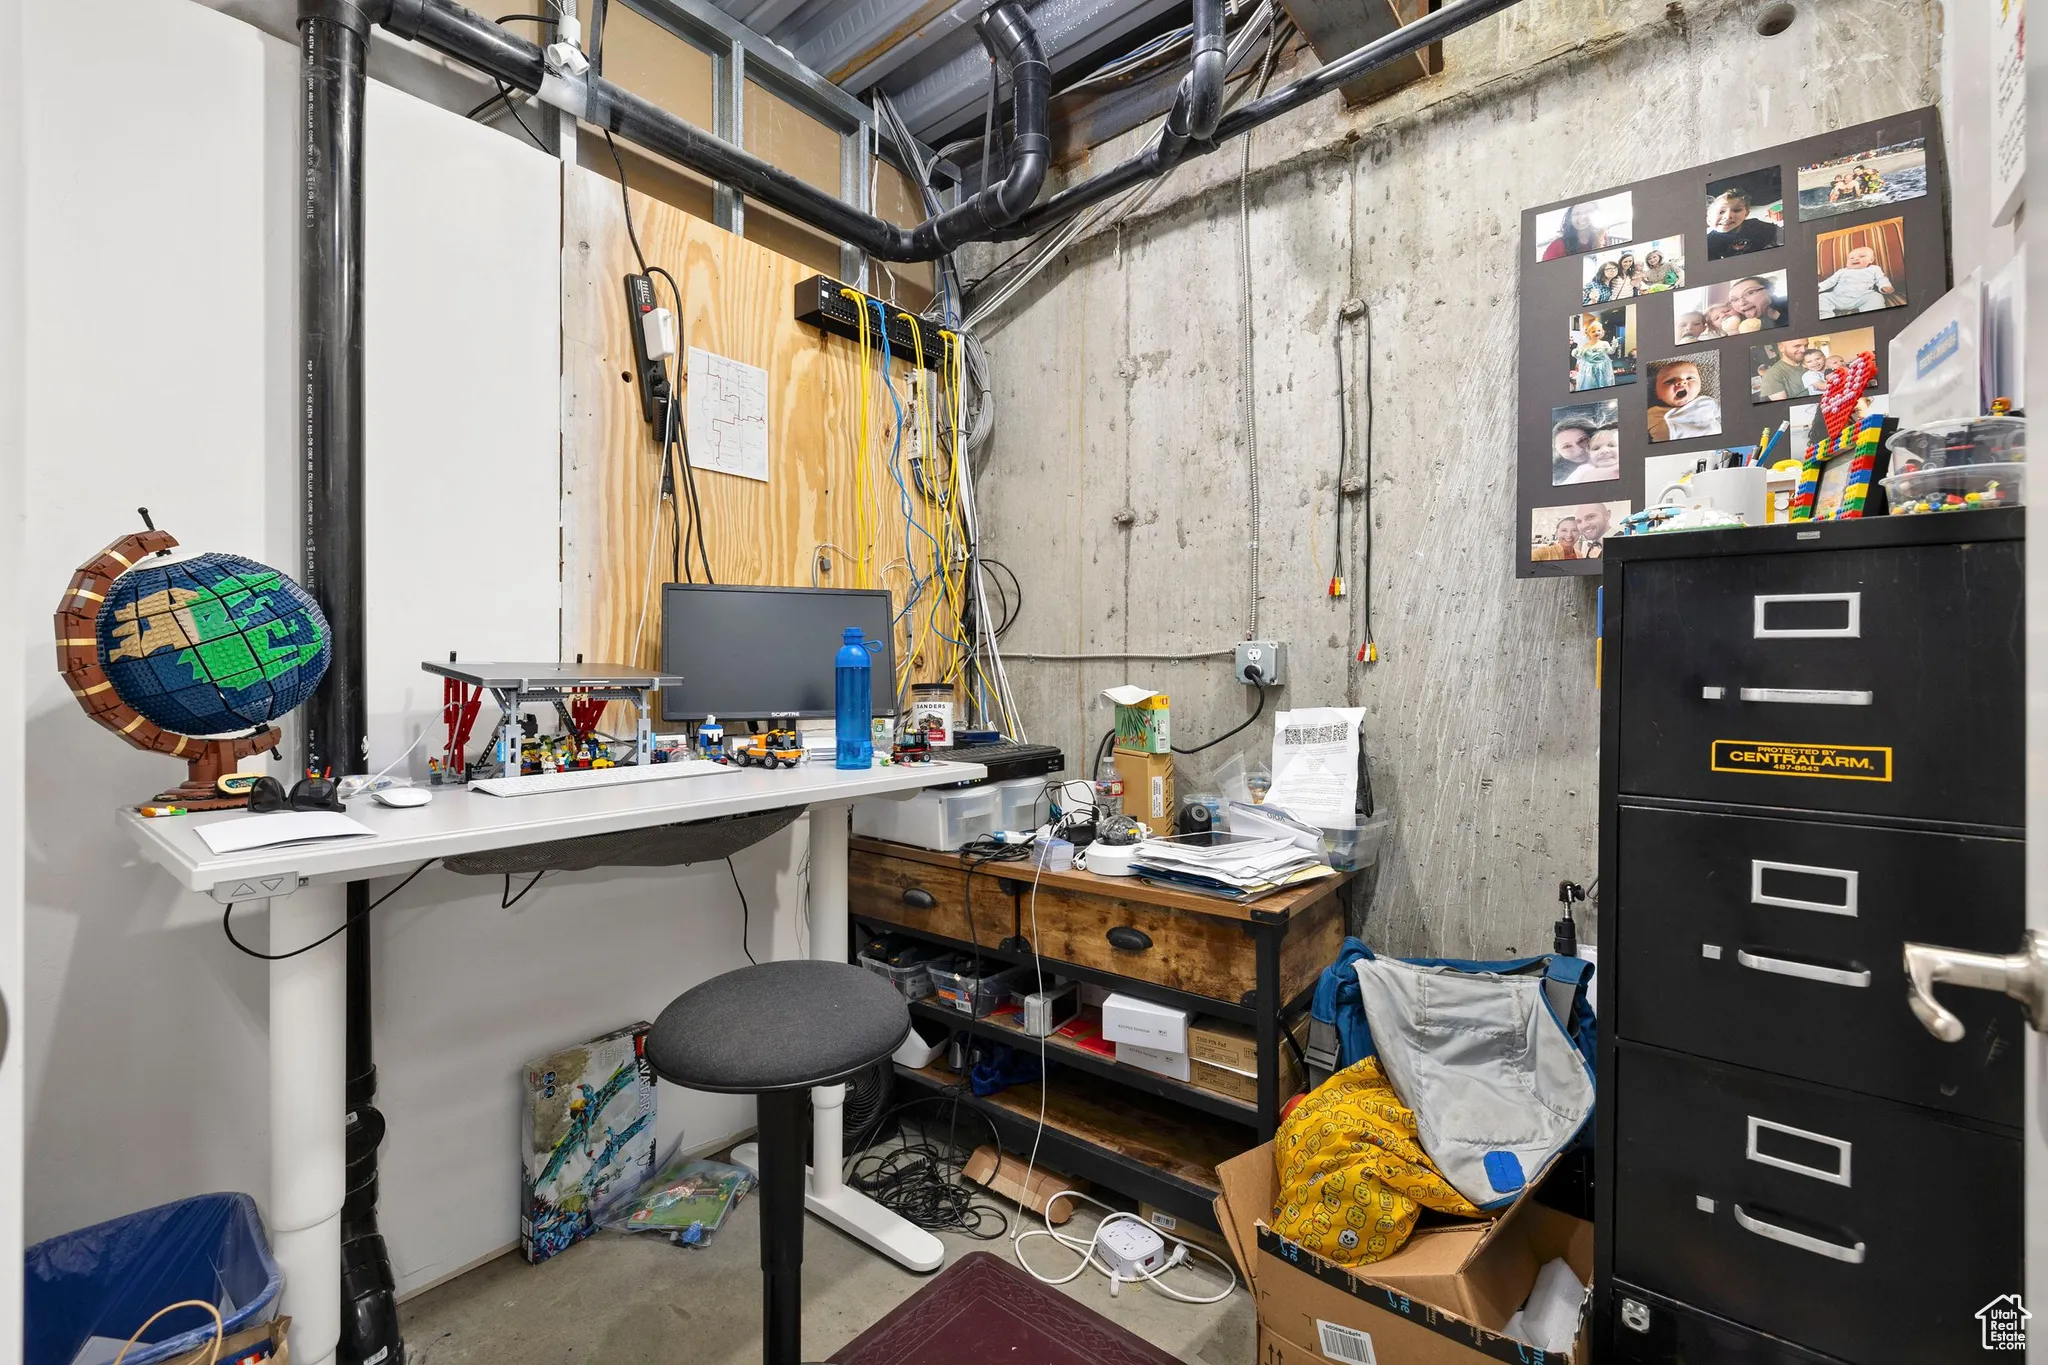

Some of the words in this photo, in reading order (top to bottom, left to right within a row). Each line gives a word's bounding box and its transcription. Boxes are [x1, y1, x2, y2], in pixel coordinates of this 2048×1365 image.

[1757, 746, 1819, 755] PROTECTED
[1729, 751, 1869, 769] CENTRALARM
[638, 1058, 652, 1114] AVATAR
